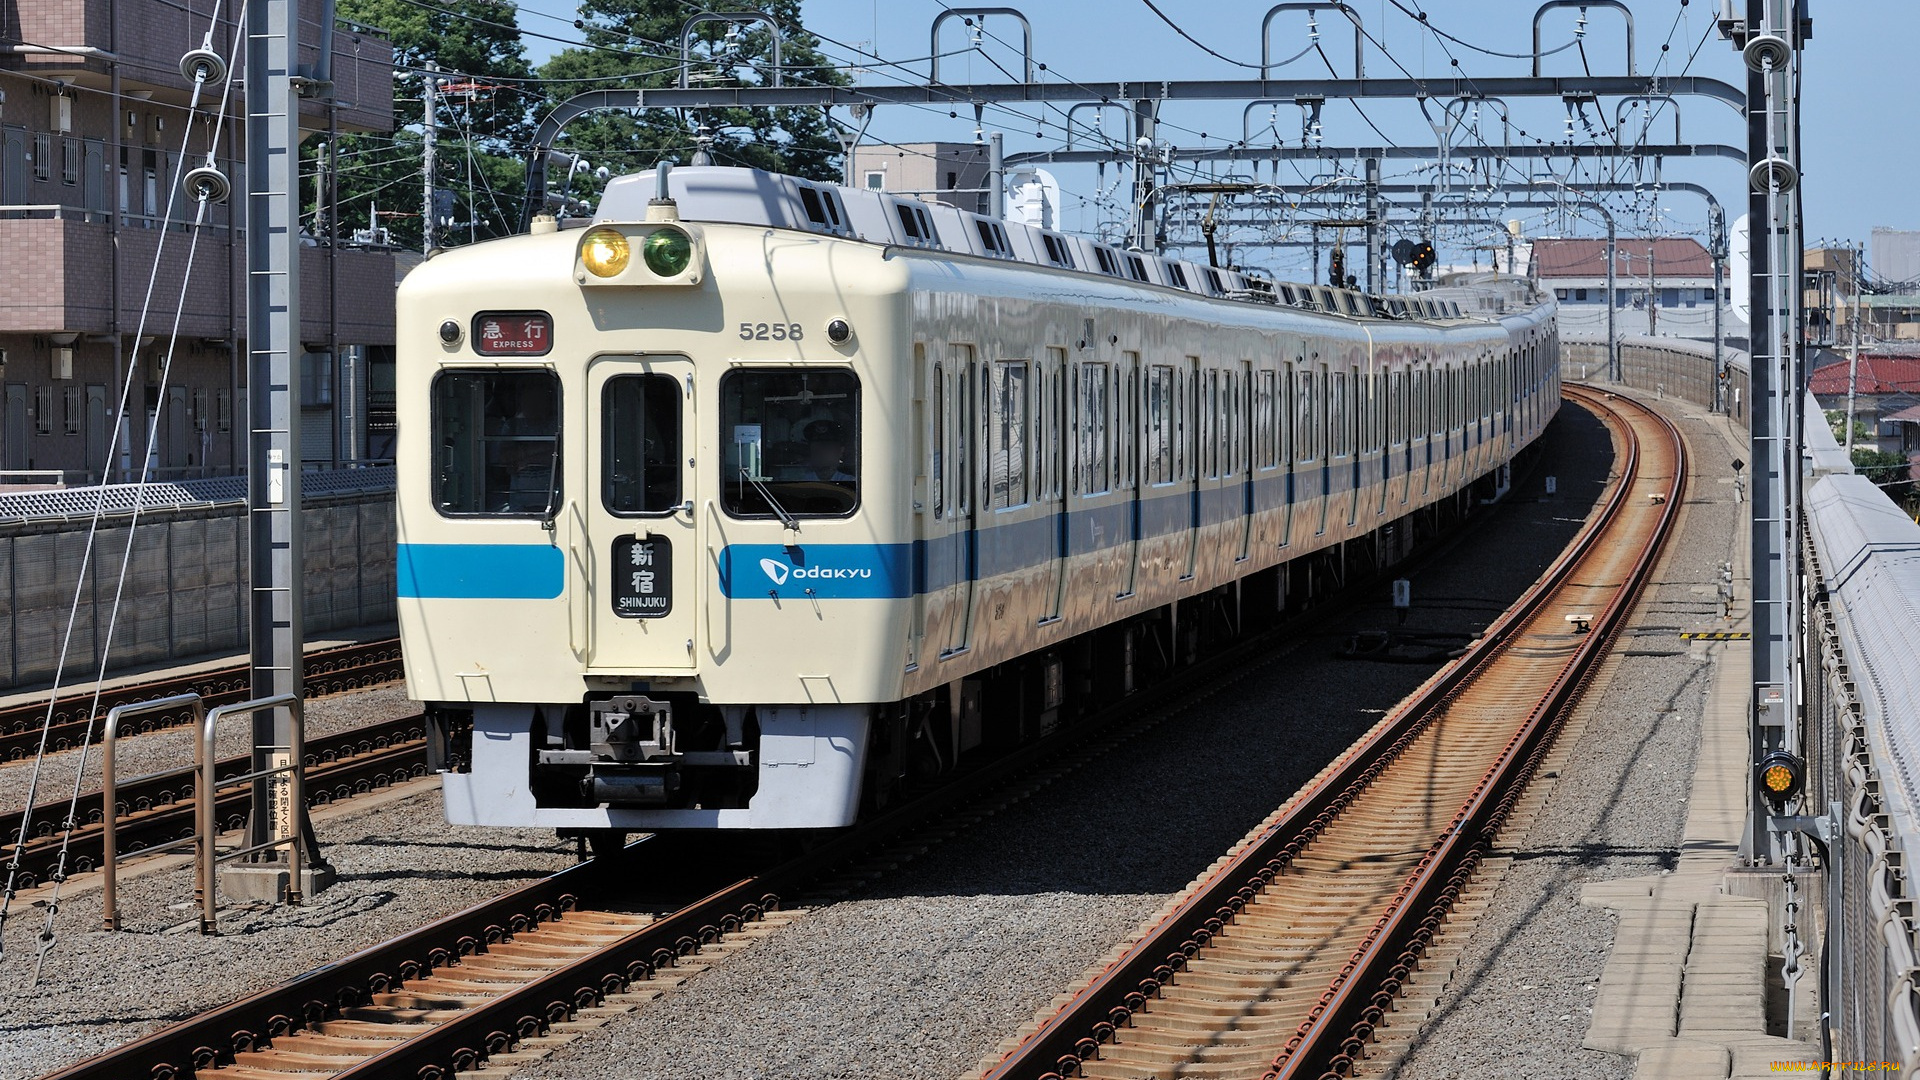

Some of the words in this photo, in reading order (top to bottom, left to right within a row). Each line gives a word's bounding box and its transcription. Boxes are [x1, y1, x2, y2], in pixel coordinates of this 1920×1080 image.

[483, 320, 544, 339] 急行
[739, 323, 804, 341] 5258
[493, 340, 534, 348] EXPRESS
[630, 542, 655, 594] 新宿
[793, 565, 872, 579] odakyu
[619, 597, 667, 608] SHINJUKU
